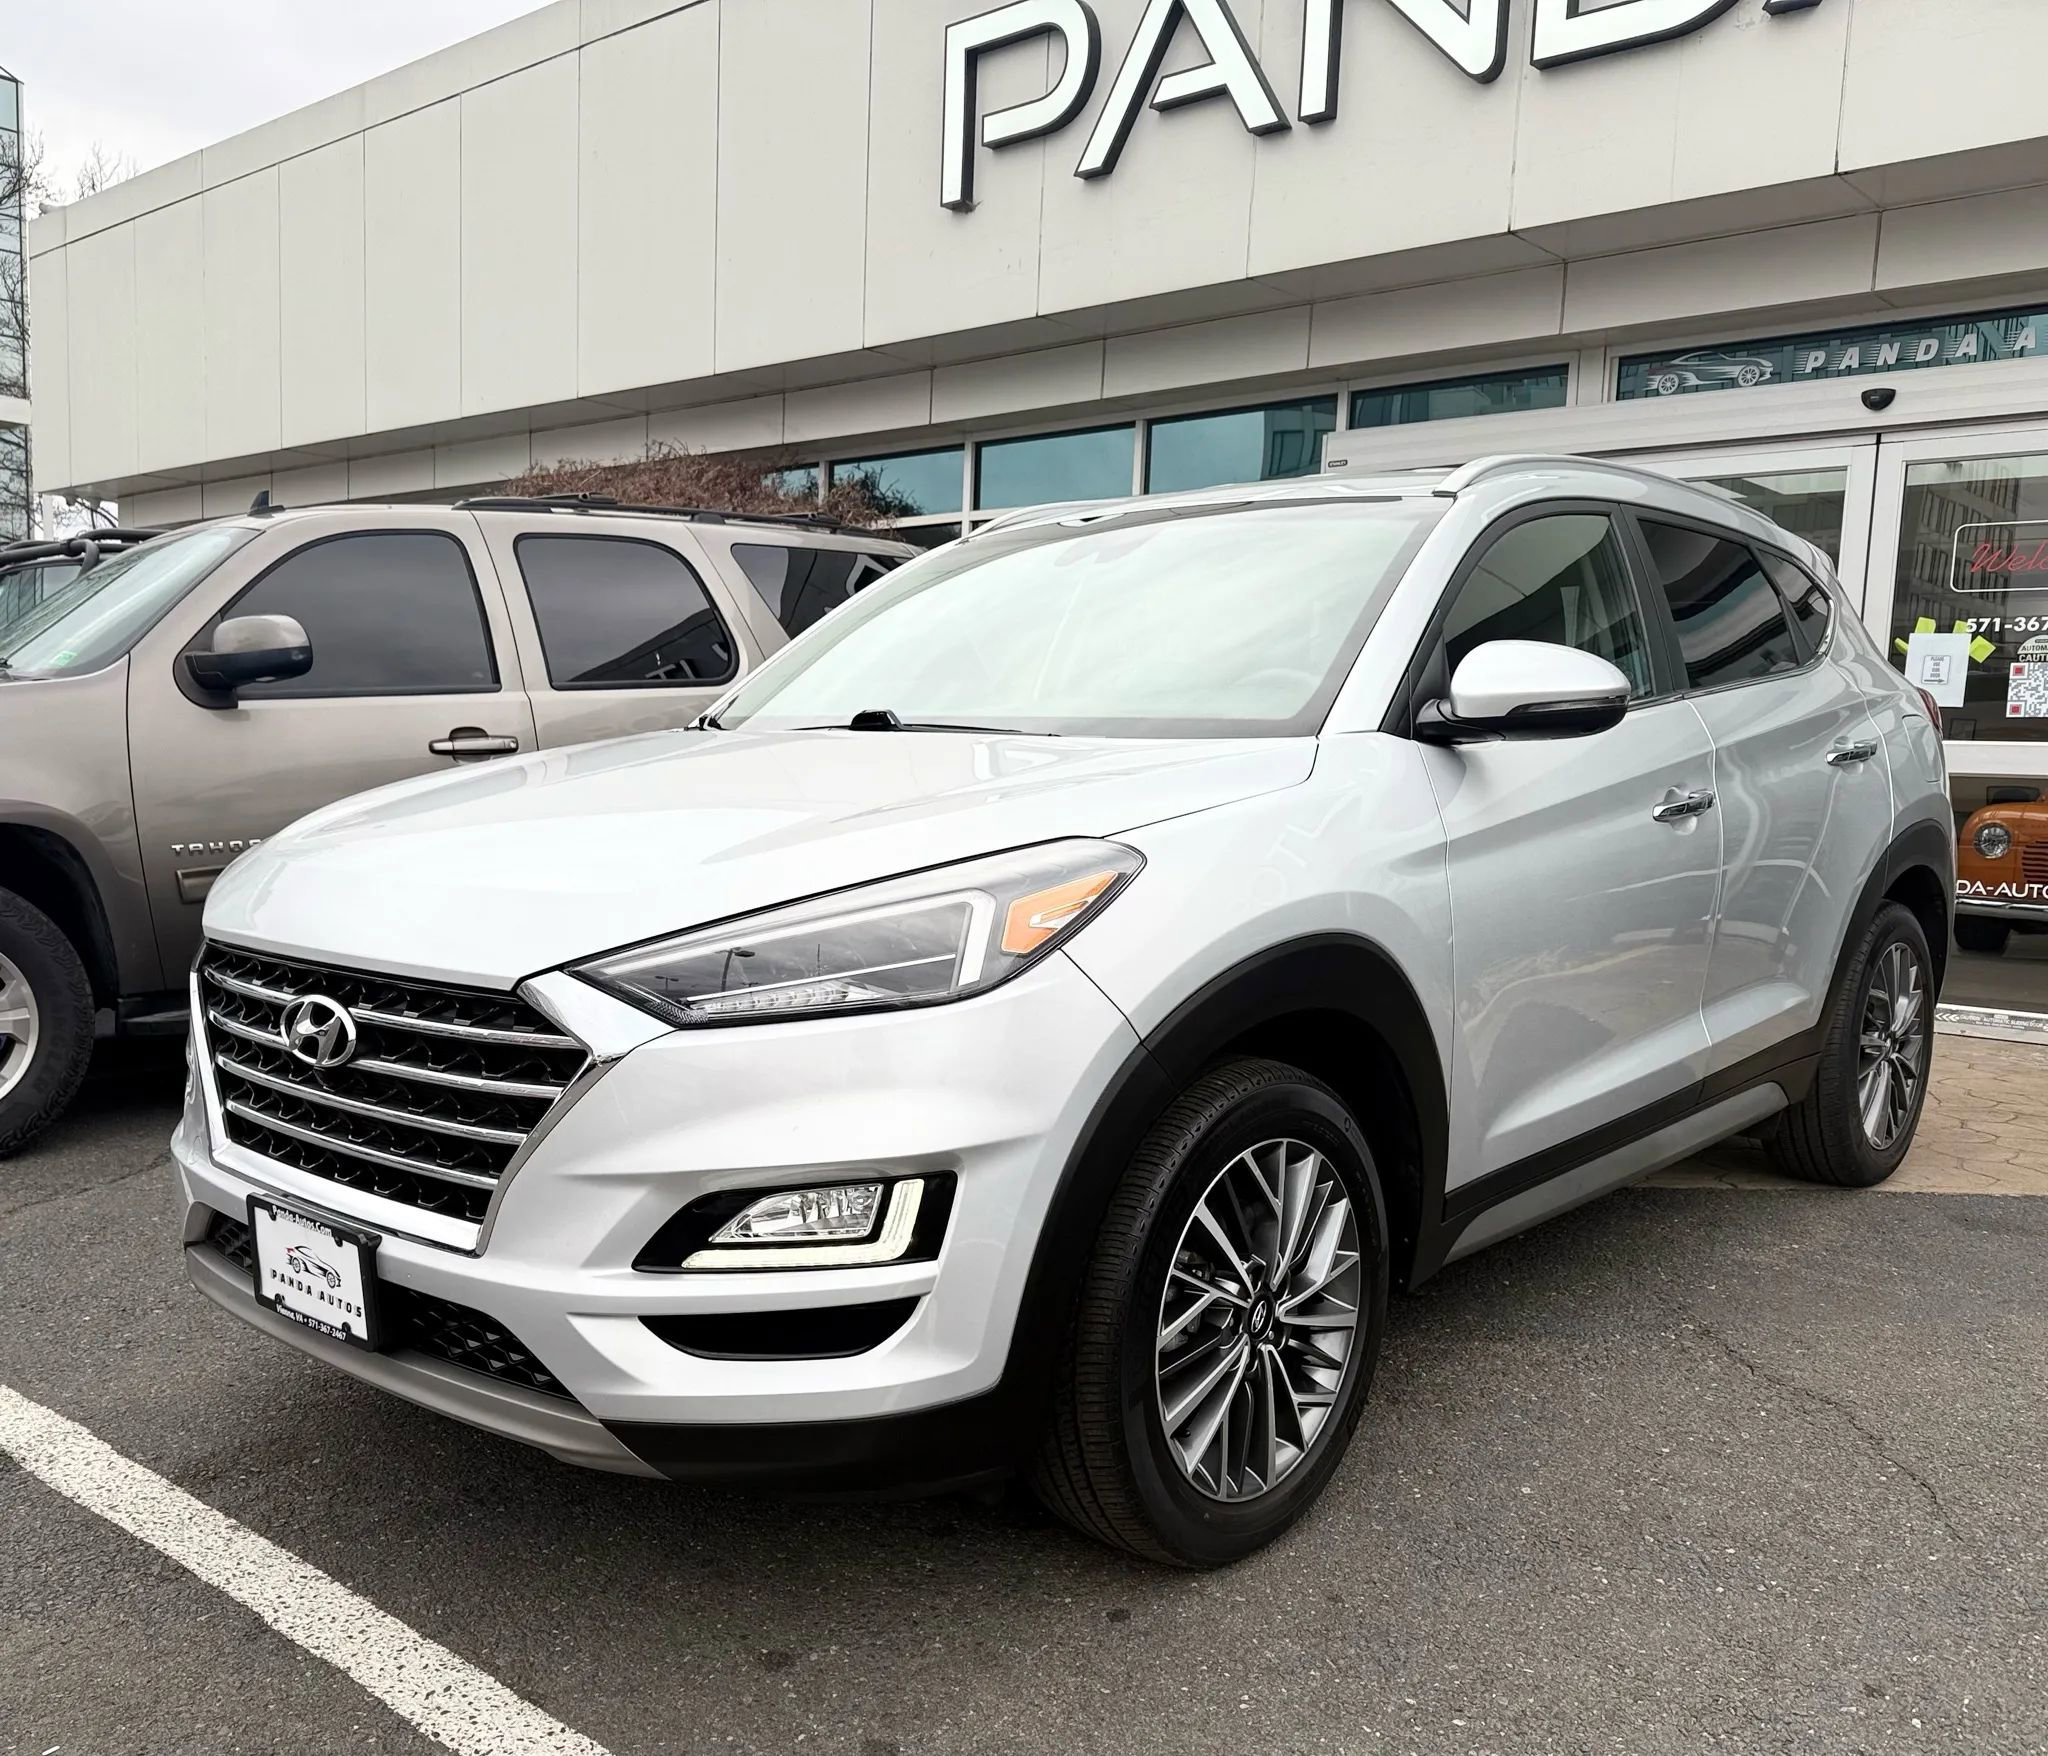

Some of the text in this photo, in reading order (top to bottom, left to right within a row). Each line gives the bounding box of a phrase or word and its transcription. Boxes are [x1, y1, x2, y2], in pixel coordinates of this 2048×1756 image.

[940, 0, 1823, 212] PAN
[1802, 332, 1978, 373] PANDA
[1966, 616, 2048, 633] 571-367
[270, 1269, 362, 1318] PANDA AUTOS
[295, 1312, 304, 1324] VA
[308, 1318, 347, 1341] 571-367-2467
